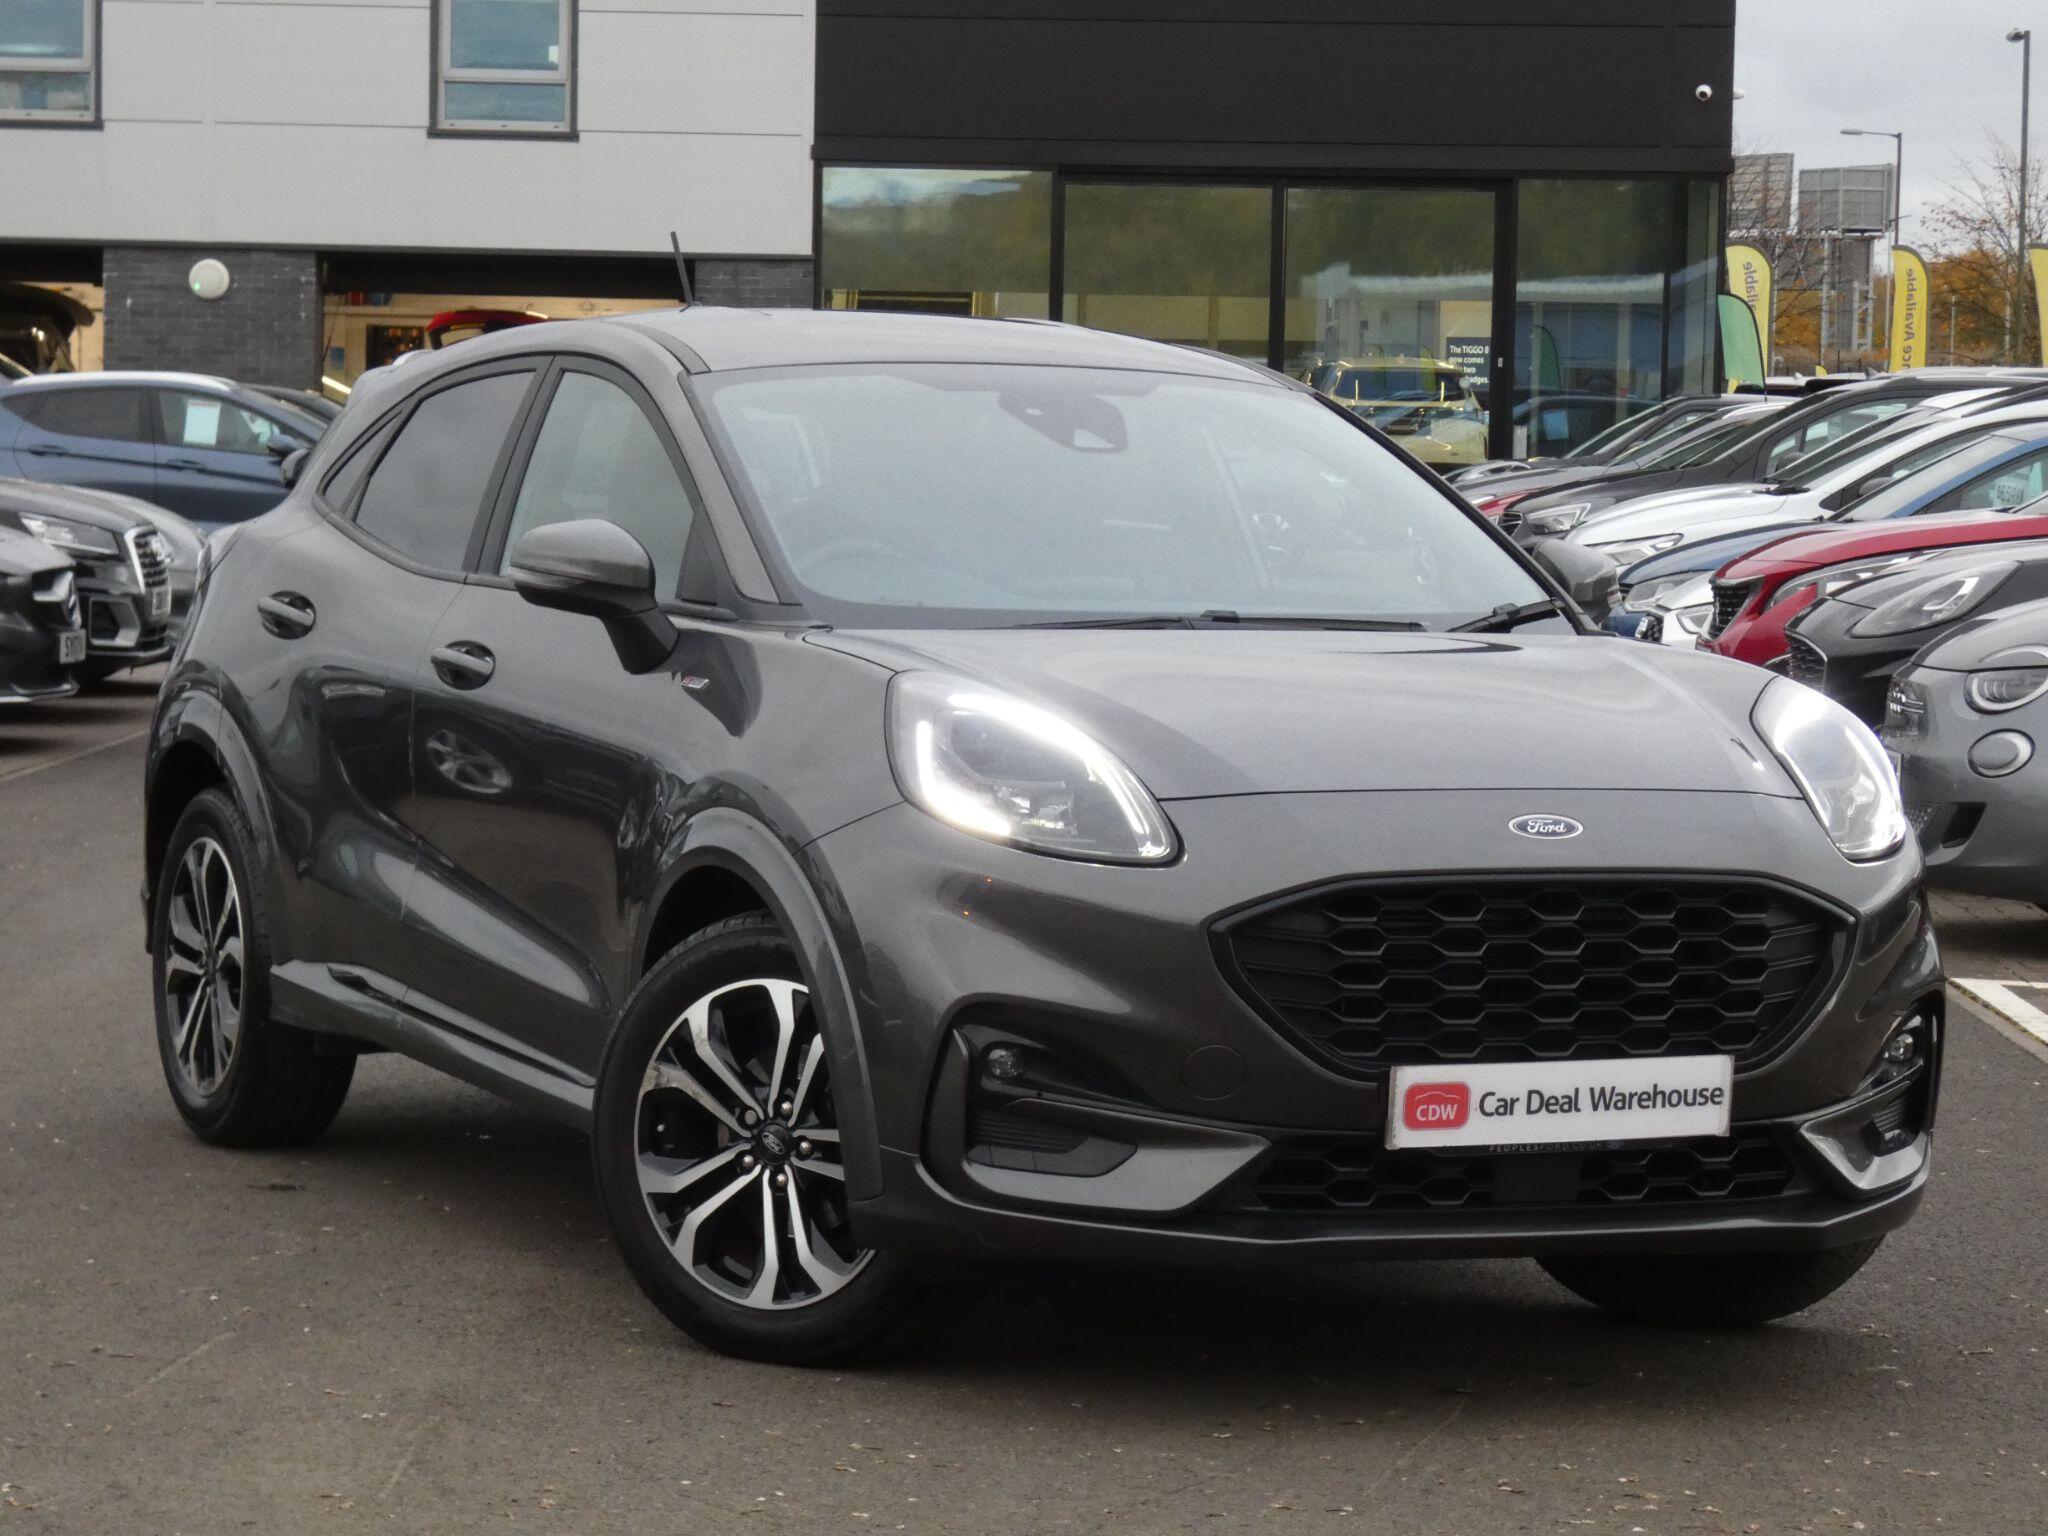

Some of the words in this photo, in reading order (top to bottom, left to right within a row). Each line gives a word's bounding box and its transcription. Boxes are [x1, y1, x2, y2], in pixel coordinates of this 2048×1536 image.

[1450, 345, 1462, 354] The
[1462, 345, 1484, 354] TIGGO
[1526, 819, 1567, 834] Ford
[1479, 1091, 1520, 1117] Car
[1525, 1087, 1581, 1115] Deal
[1589, 1083, 1725, 1113] Warehouse
[1415, 1103, 1458, 1122] CDW
